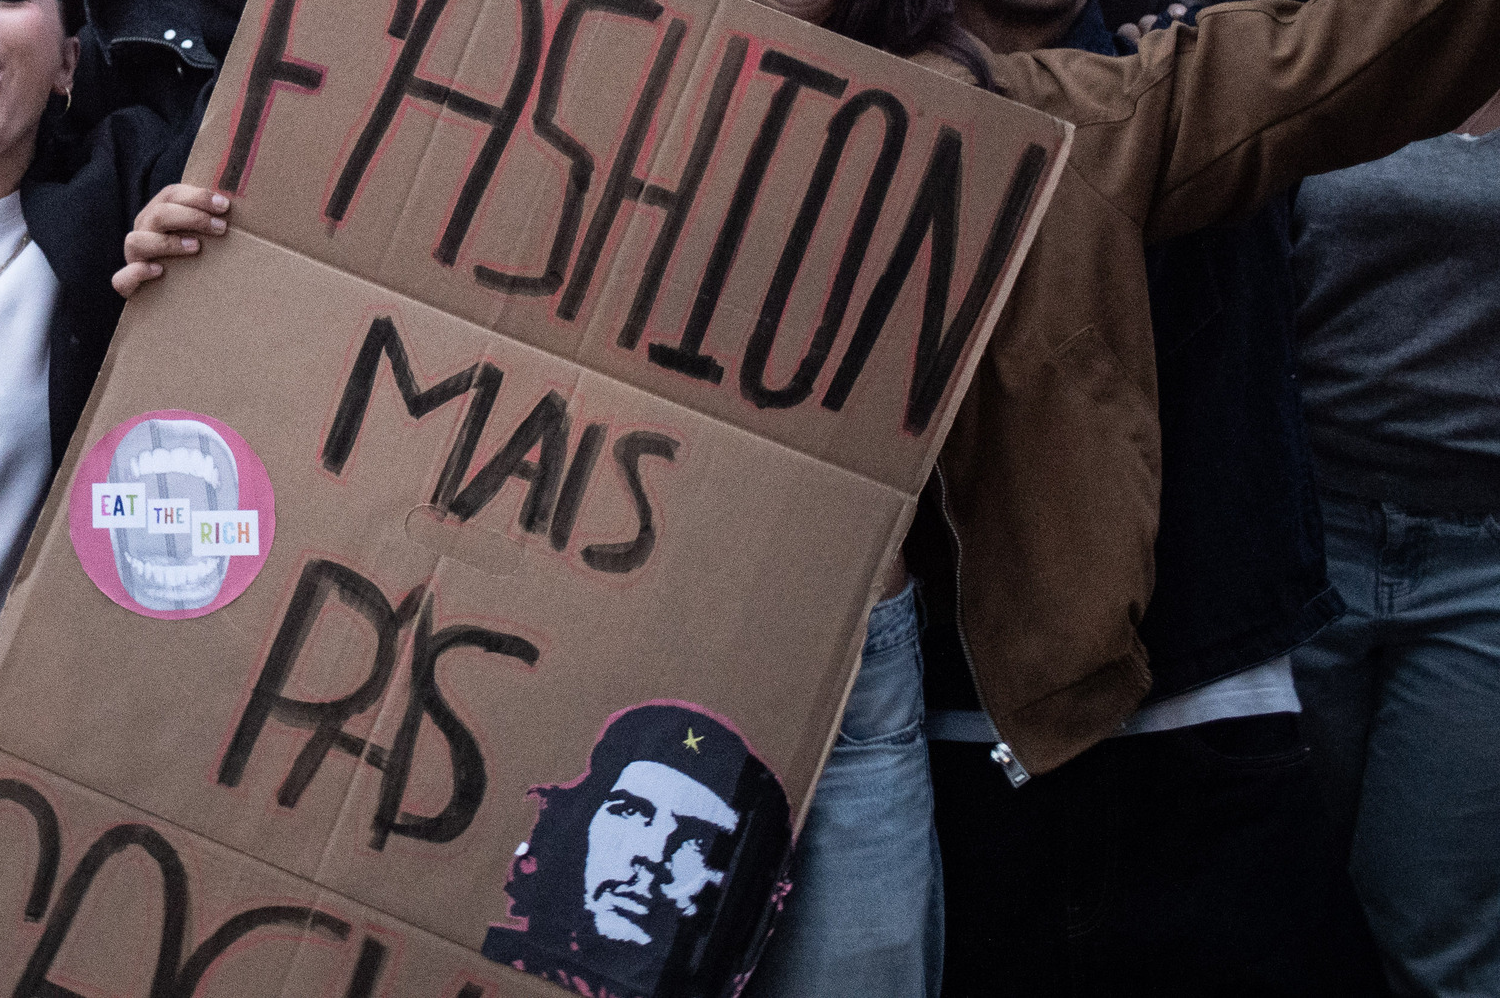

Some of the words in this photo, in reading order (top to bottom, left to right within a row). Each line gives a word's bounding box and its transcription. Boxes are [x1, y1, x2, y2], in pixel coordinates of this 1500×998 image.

[101, 494, 139, 517] EAT
[153, 507, 186, 524] THE
[200, 521, 251, 545] RICH
[321, 314, 683, 574] MAIS
[216, 557, 543, 852] PAS
